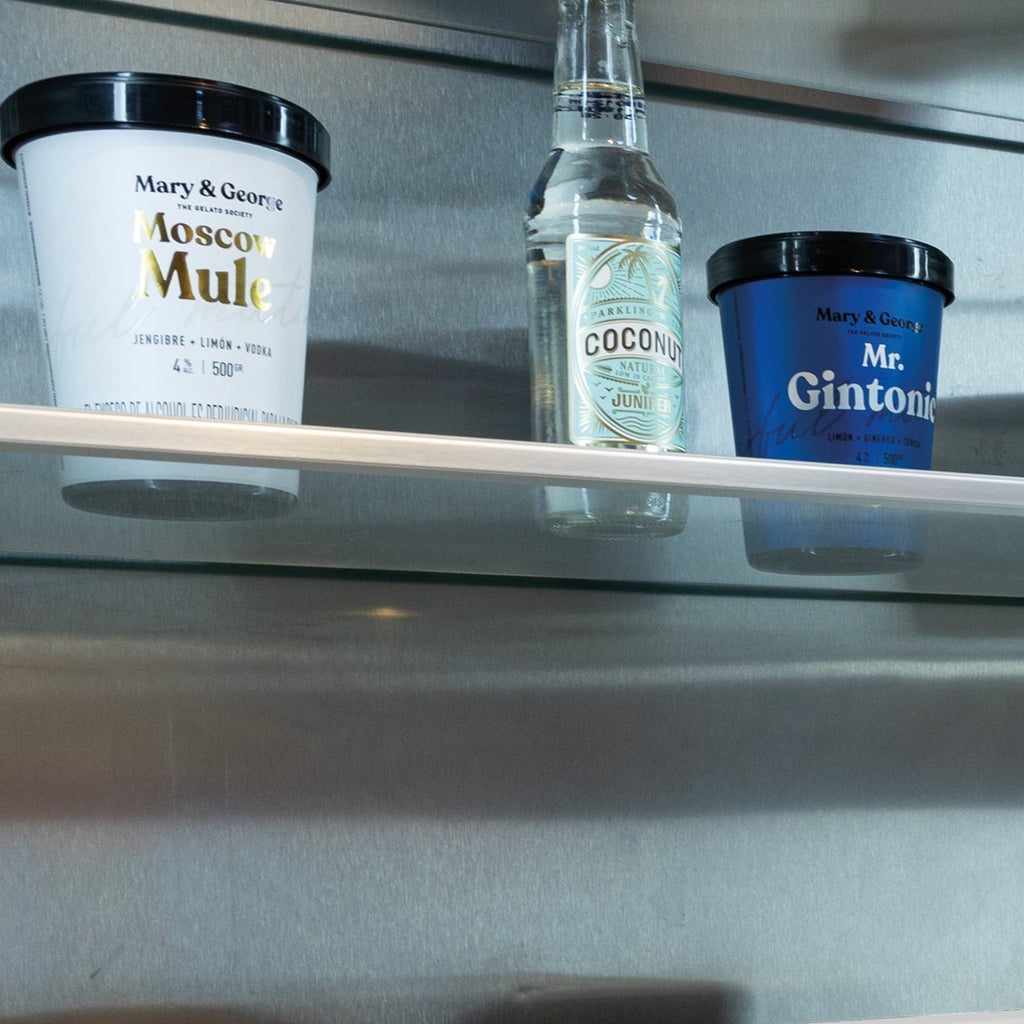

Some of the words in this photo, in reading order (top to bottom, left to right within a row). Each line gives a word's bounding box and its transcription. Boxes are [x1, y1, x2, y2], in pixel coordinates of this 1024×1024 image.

[135, 175, 194, 200] Mary
[200, 179, 217, 198] &
[221, 182, 284, 212] George
[194, 205, 223, 214] GELATO
[225, 209, 253, 219] SOCIETY
[132, 210, 277, 259] Moscow
[138, 249, 271, 313] Mule
[816, 307, 860, 326] Mary
[864, 310, 876, 325] &
[133, 334, 185, 347] JENGIBRE
[200, 336, 232, 350] LIMÓN
[245, 342, 272, 357] VODKA
[862, 342, 905, 371] Mr.
[787, 369, 936, 424] Gintonic
